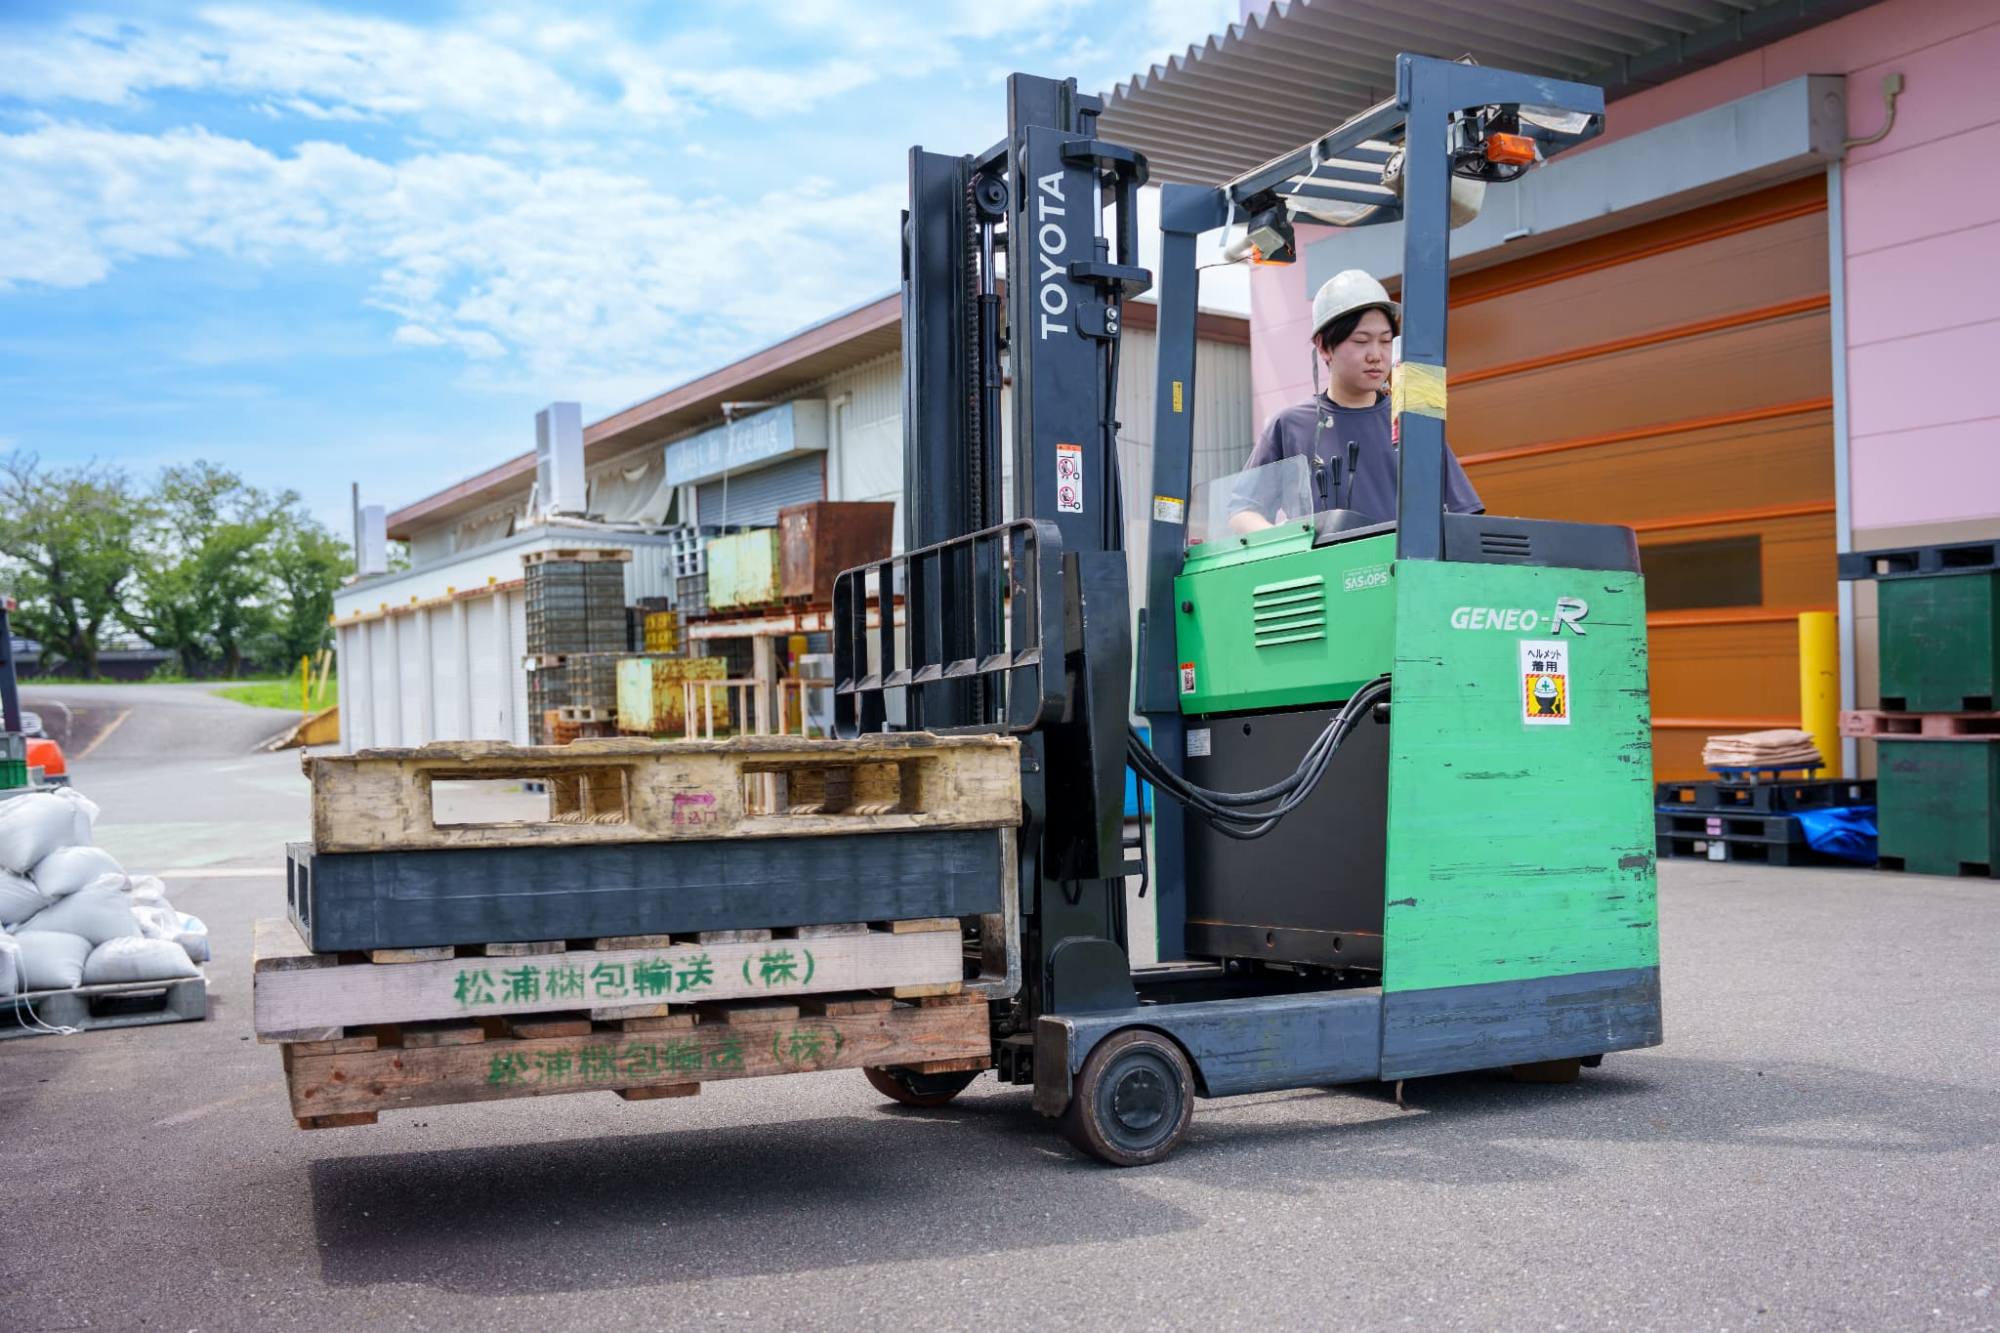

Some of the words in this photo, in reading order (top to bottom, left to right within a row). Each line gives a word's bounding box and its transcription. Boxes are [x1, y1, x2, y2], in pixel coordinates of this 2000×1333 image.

[1038, 171, 1068, 340] TOYOTA
[1450, 596, 1589, 635] GENEO-R
[1527, 649, 1562, 660] ヘルメット
[1531, 660, 1558, 673] 着用
